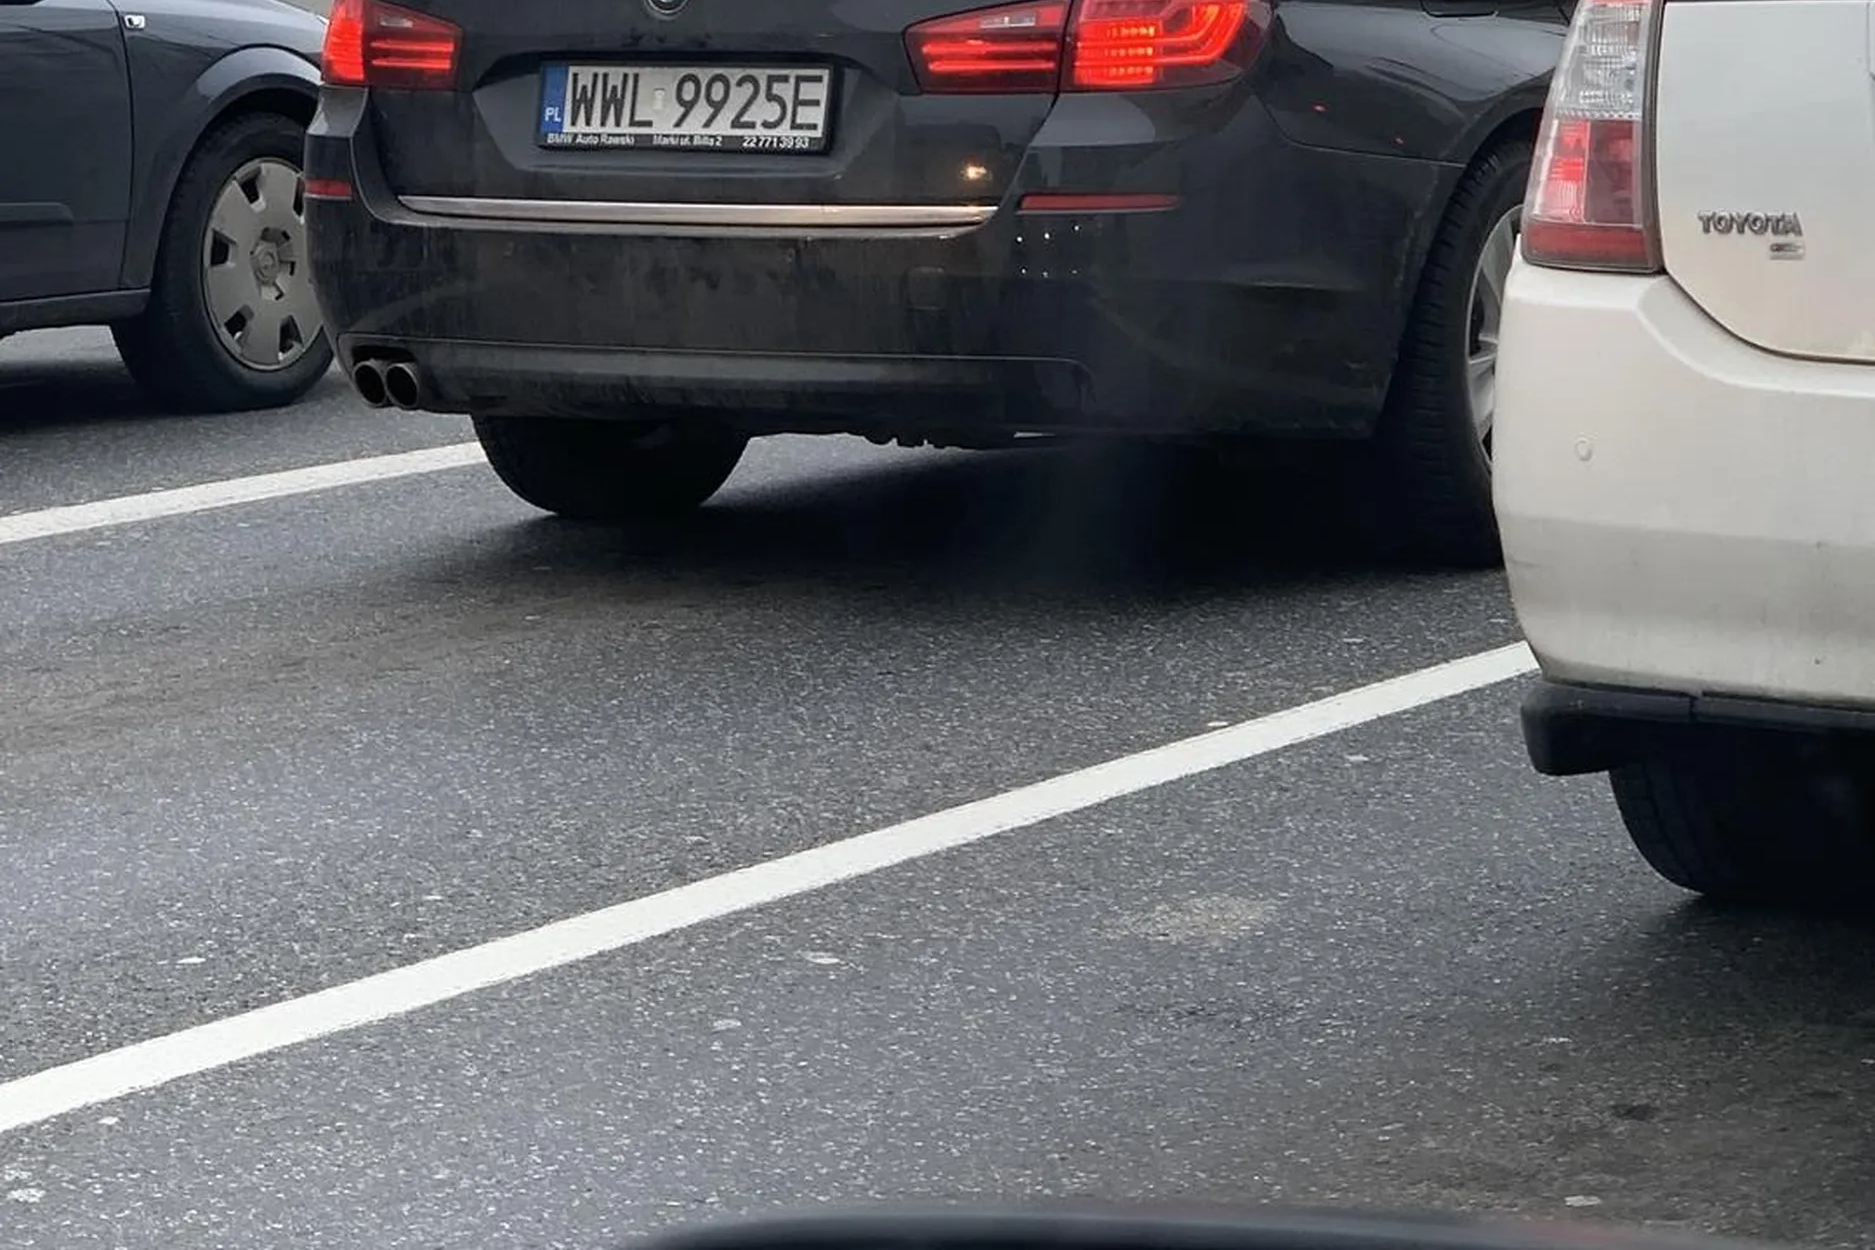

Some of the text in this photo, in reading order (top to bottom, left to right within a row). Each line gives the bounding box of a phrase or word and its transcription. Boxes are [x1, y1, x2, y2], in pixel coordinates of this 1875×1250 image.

[570, 72, 823, 131] WWL 9925E
[545, 107, 561, 121] PL
[575, 134, 599, 145] Auto
[1697, 211, 1803, 237] TOYOTA
